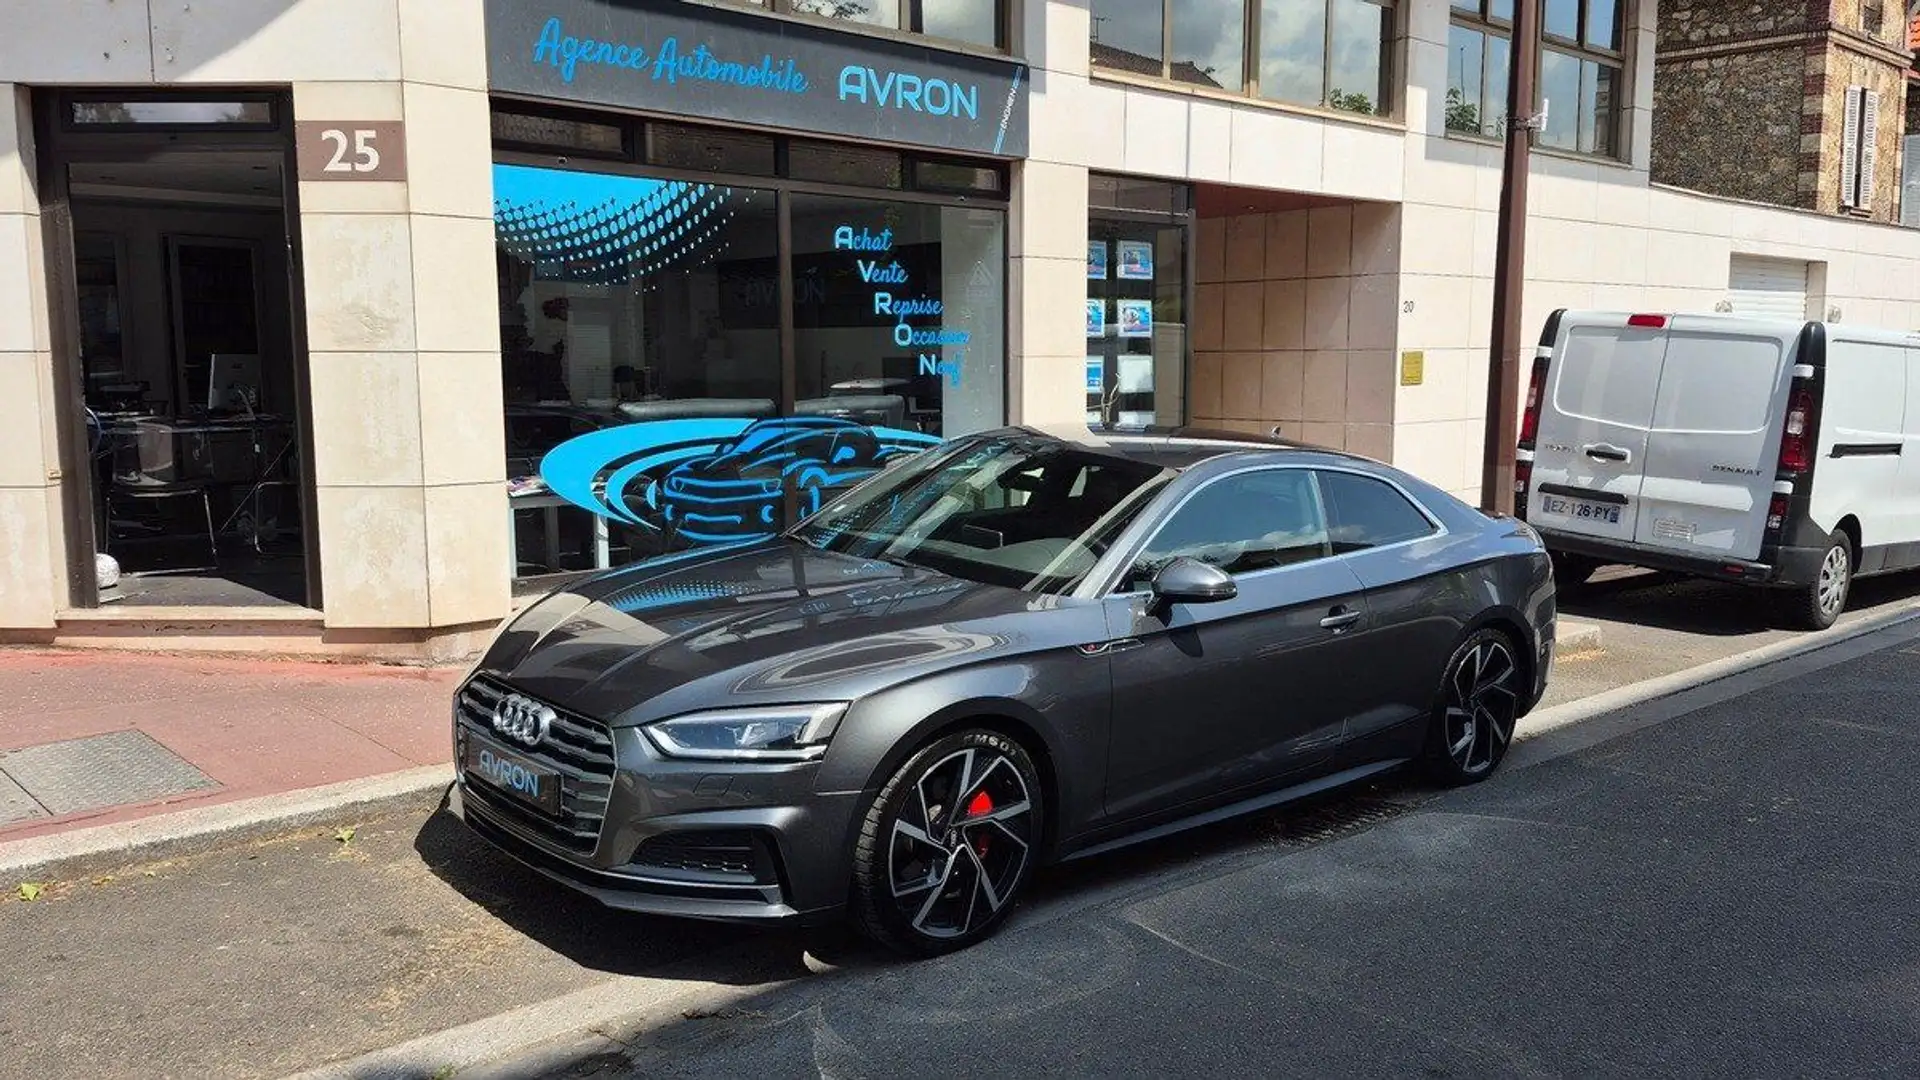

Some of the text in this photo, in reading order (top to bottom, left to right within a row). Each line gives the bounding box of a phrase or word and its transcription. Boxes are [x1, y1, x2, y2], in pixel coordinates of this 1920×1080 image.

[534, 17, 978, 120] Agence Automobile AVRON
[321, 129, 379, 172] 25
[834, 225, 893, 251] Achat
[857, 259, 908, 283] Vente
[875, 291, 944, 323] Reprise
[478, 749, 539, 798] AVRON
